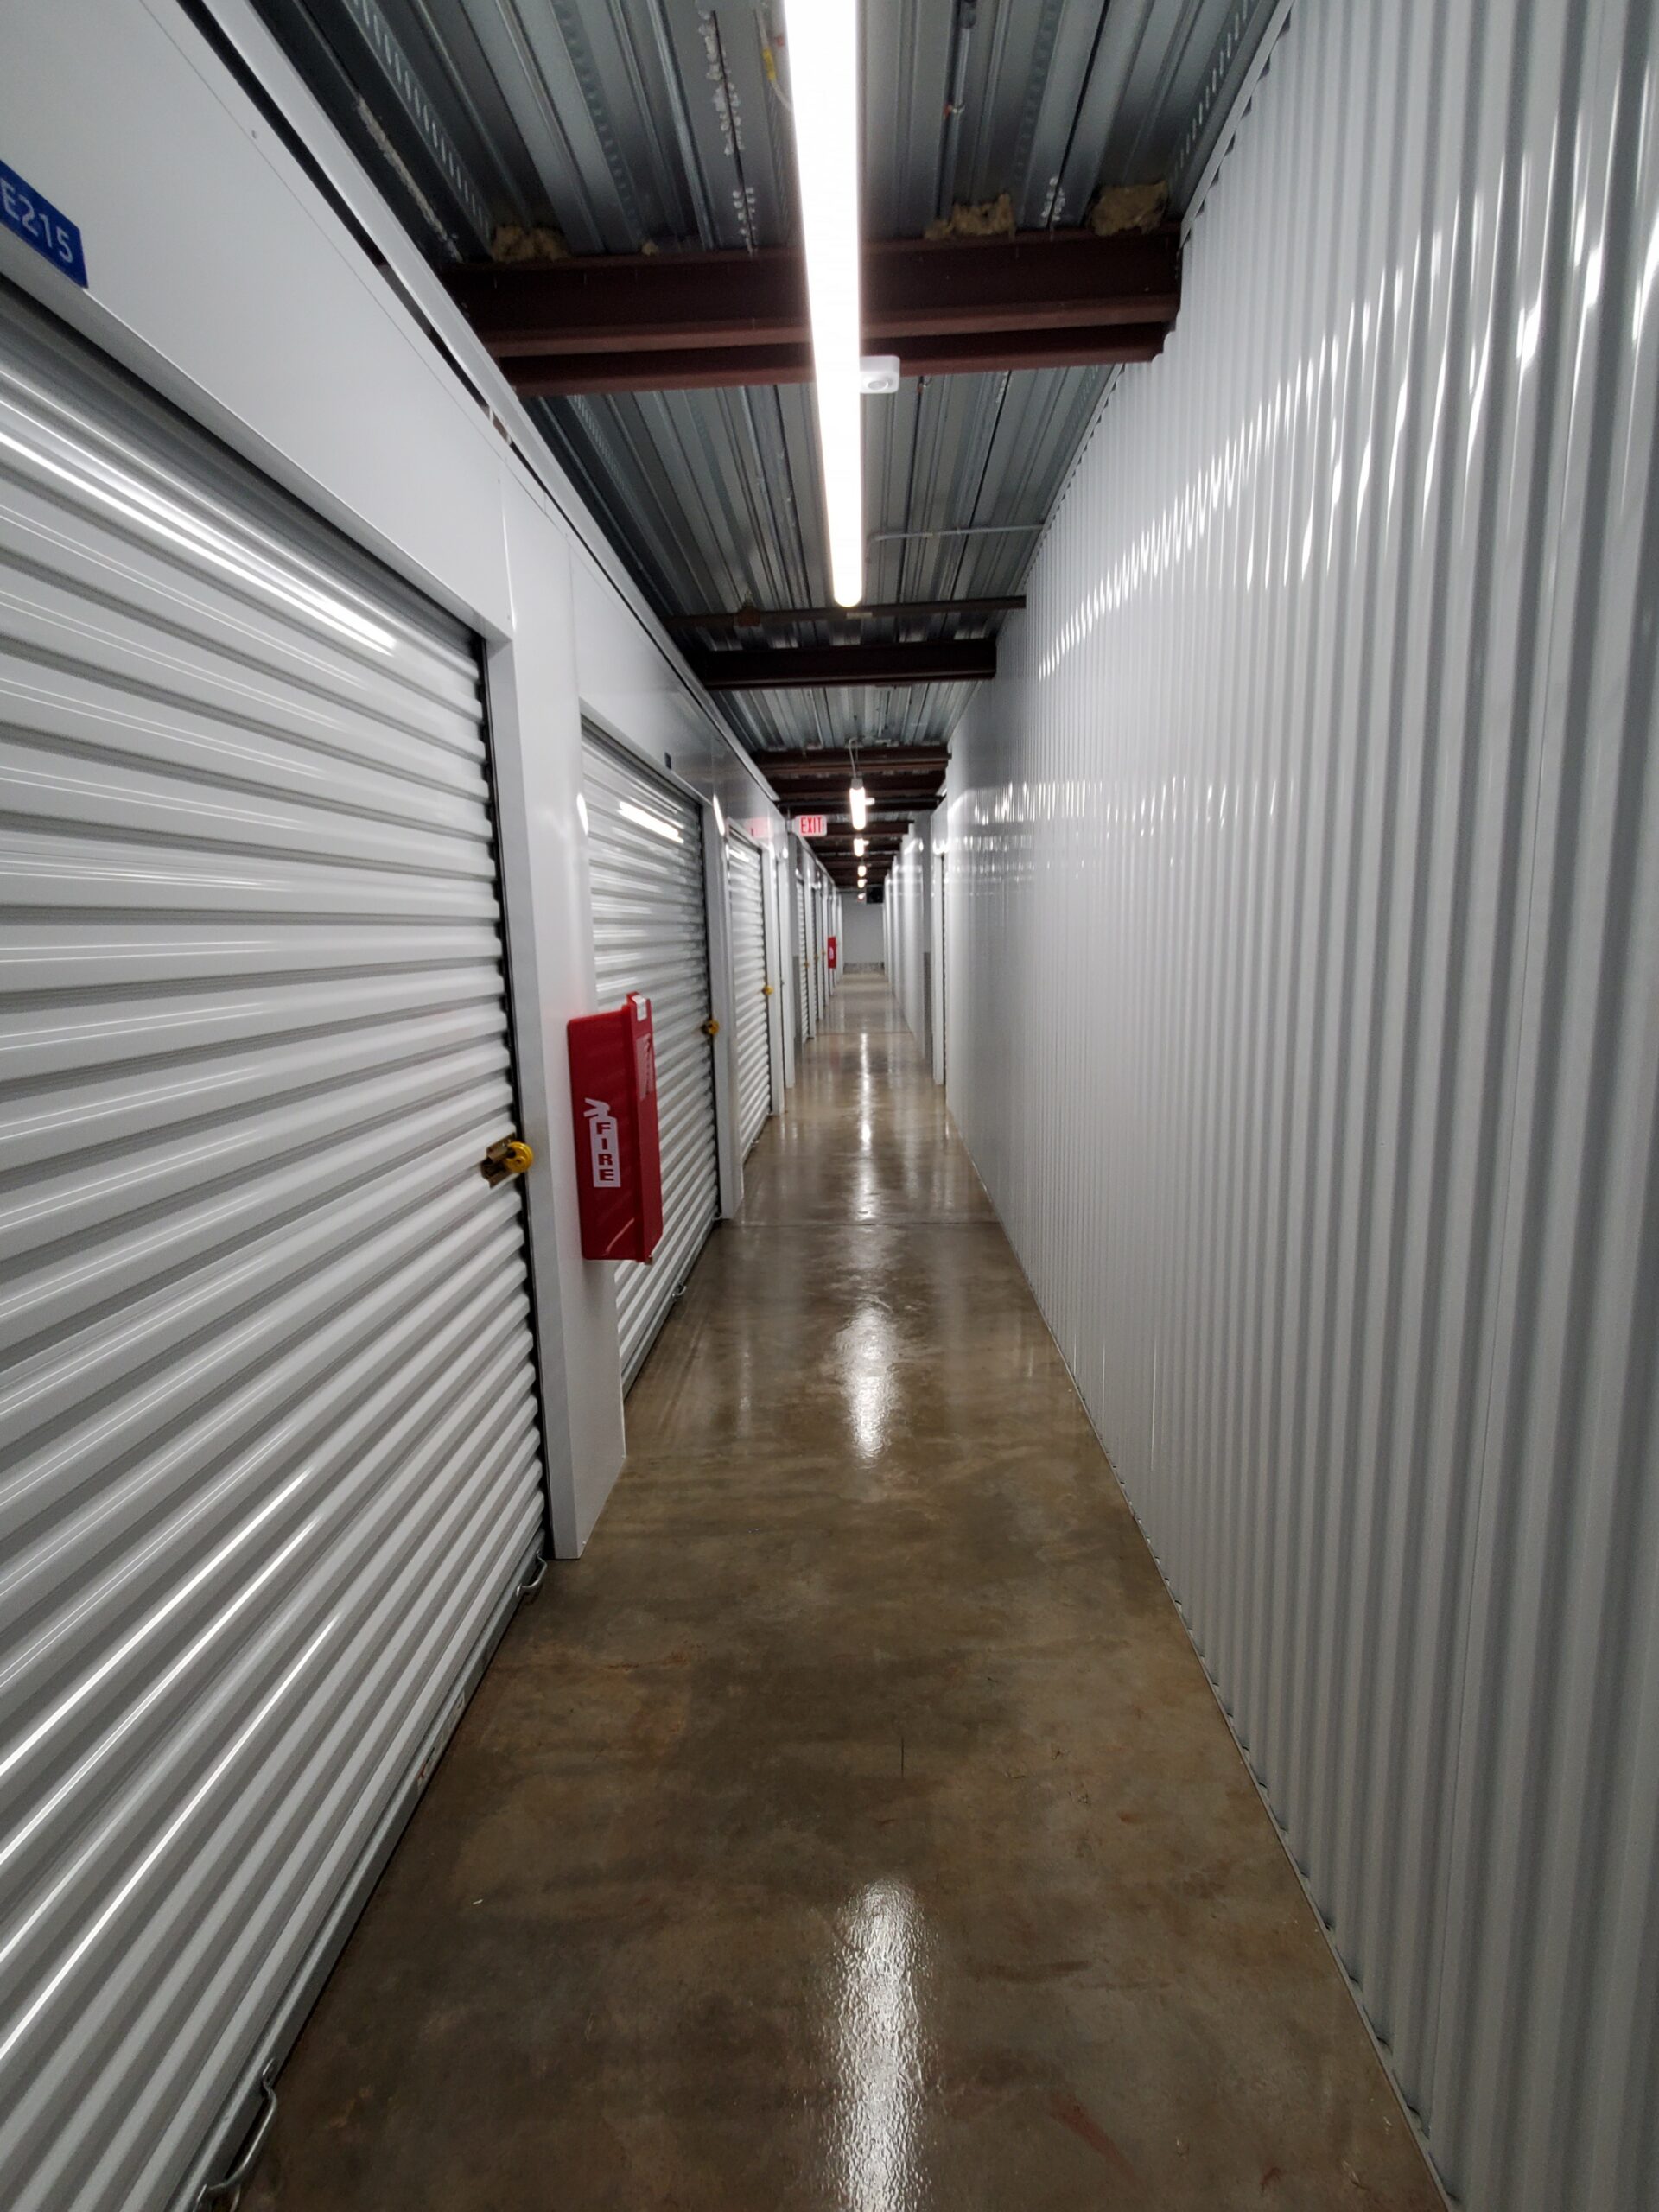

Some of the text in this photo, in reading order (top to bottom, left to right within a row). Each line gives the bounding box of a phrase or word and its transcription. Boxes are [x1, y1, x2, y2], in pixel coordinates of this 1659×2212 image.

[0, 176, 73, 264] E215
[800, 817, 823, 834] EXIT
[596, 1122, 615, 1182] FIRE
